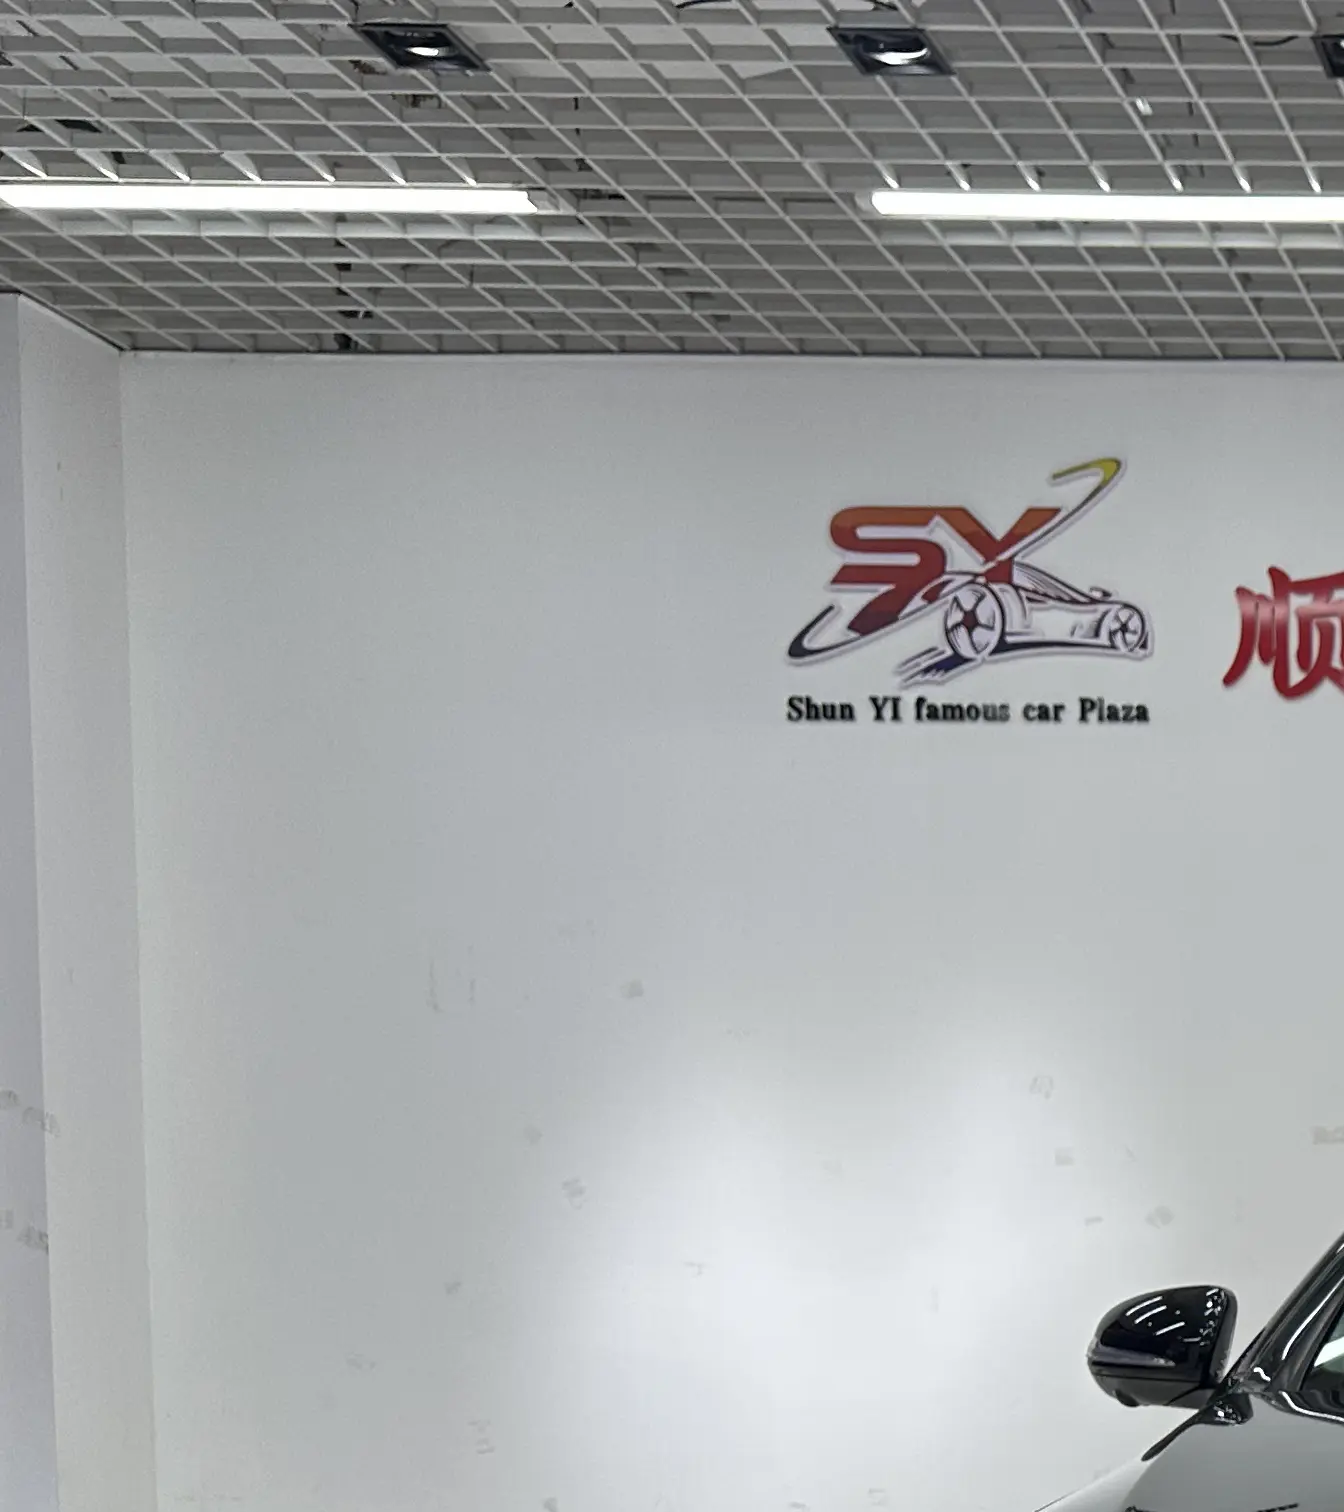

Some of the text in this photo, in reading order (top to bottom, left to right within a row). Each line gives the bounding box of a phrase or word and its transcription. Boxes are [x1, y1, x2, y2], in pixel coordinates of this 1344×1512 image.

[786, 695, 1151, 723] Shun YI famous car Plaza
